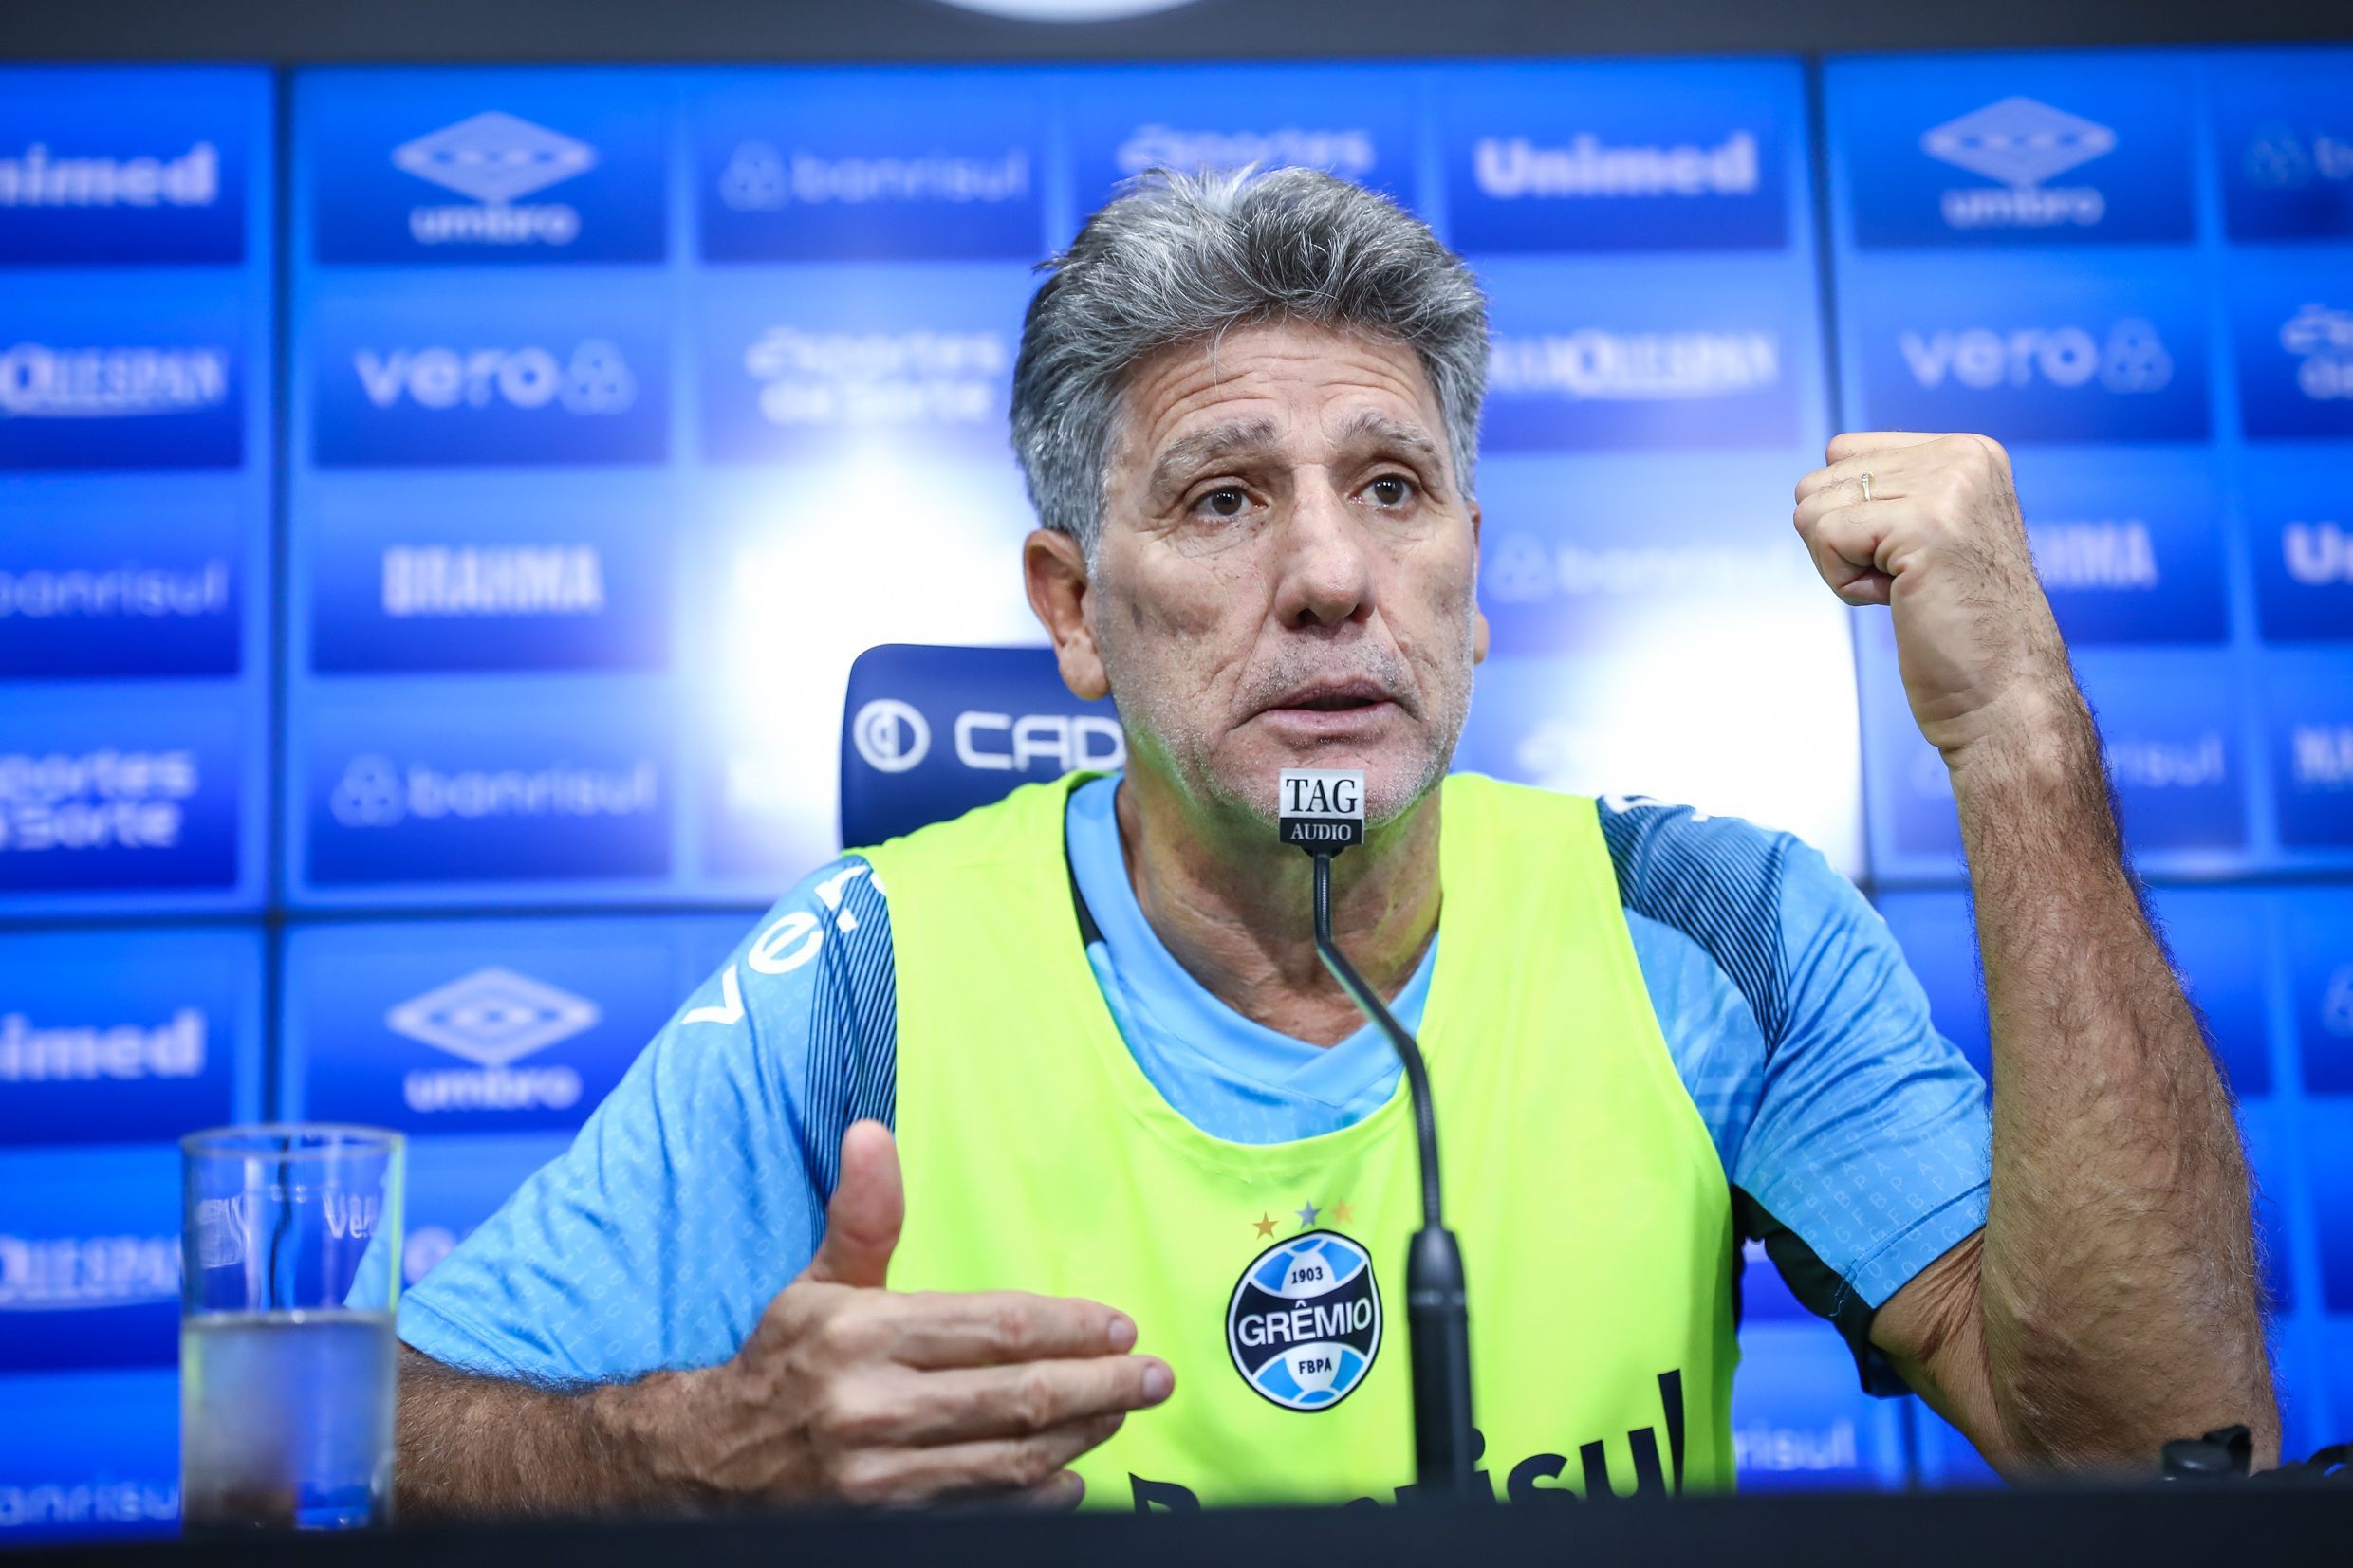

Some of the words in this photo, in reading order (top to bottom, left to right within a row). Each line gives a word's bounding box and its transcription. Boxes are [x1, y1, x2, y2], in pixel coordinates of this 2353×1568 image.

[1474, 132, 1758, 197] Unimed
[409, 204, 580, 244] umbro
[355, 346, 560, 407] vero
[1901, 328, 2099, 388] vero
[954, 710, 1127, 772] CAD
[1286, 779, 1359, 814] TAG
[1290, 823, 1352, 841] AUDIO
[681, 865, 887, 1025] ver
[404, 1068, 582, 1111] umbro
[1291, 1266, 1324, 1284] 1903
[1238, 1297, 1373, 1347] GRÊMIO
[1298, 1357, 1333, 1375] FBPA
